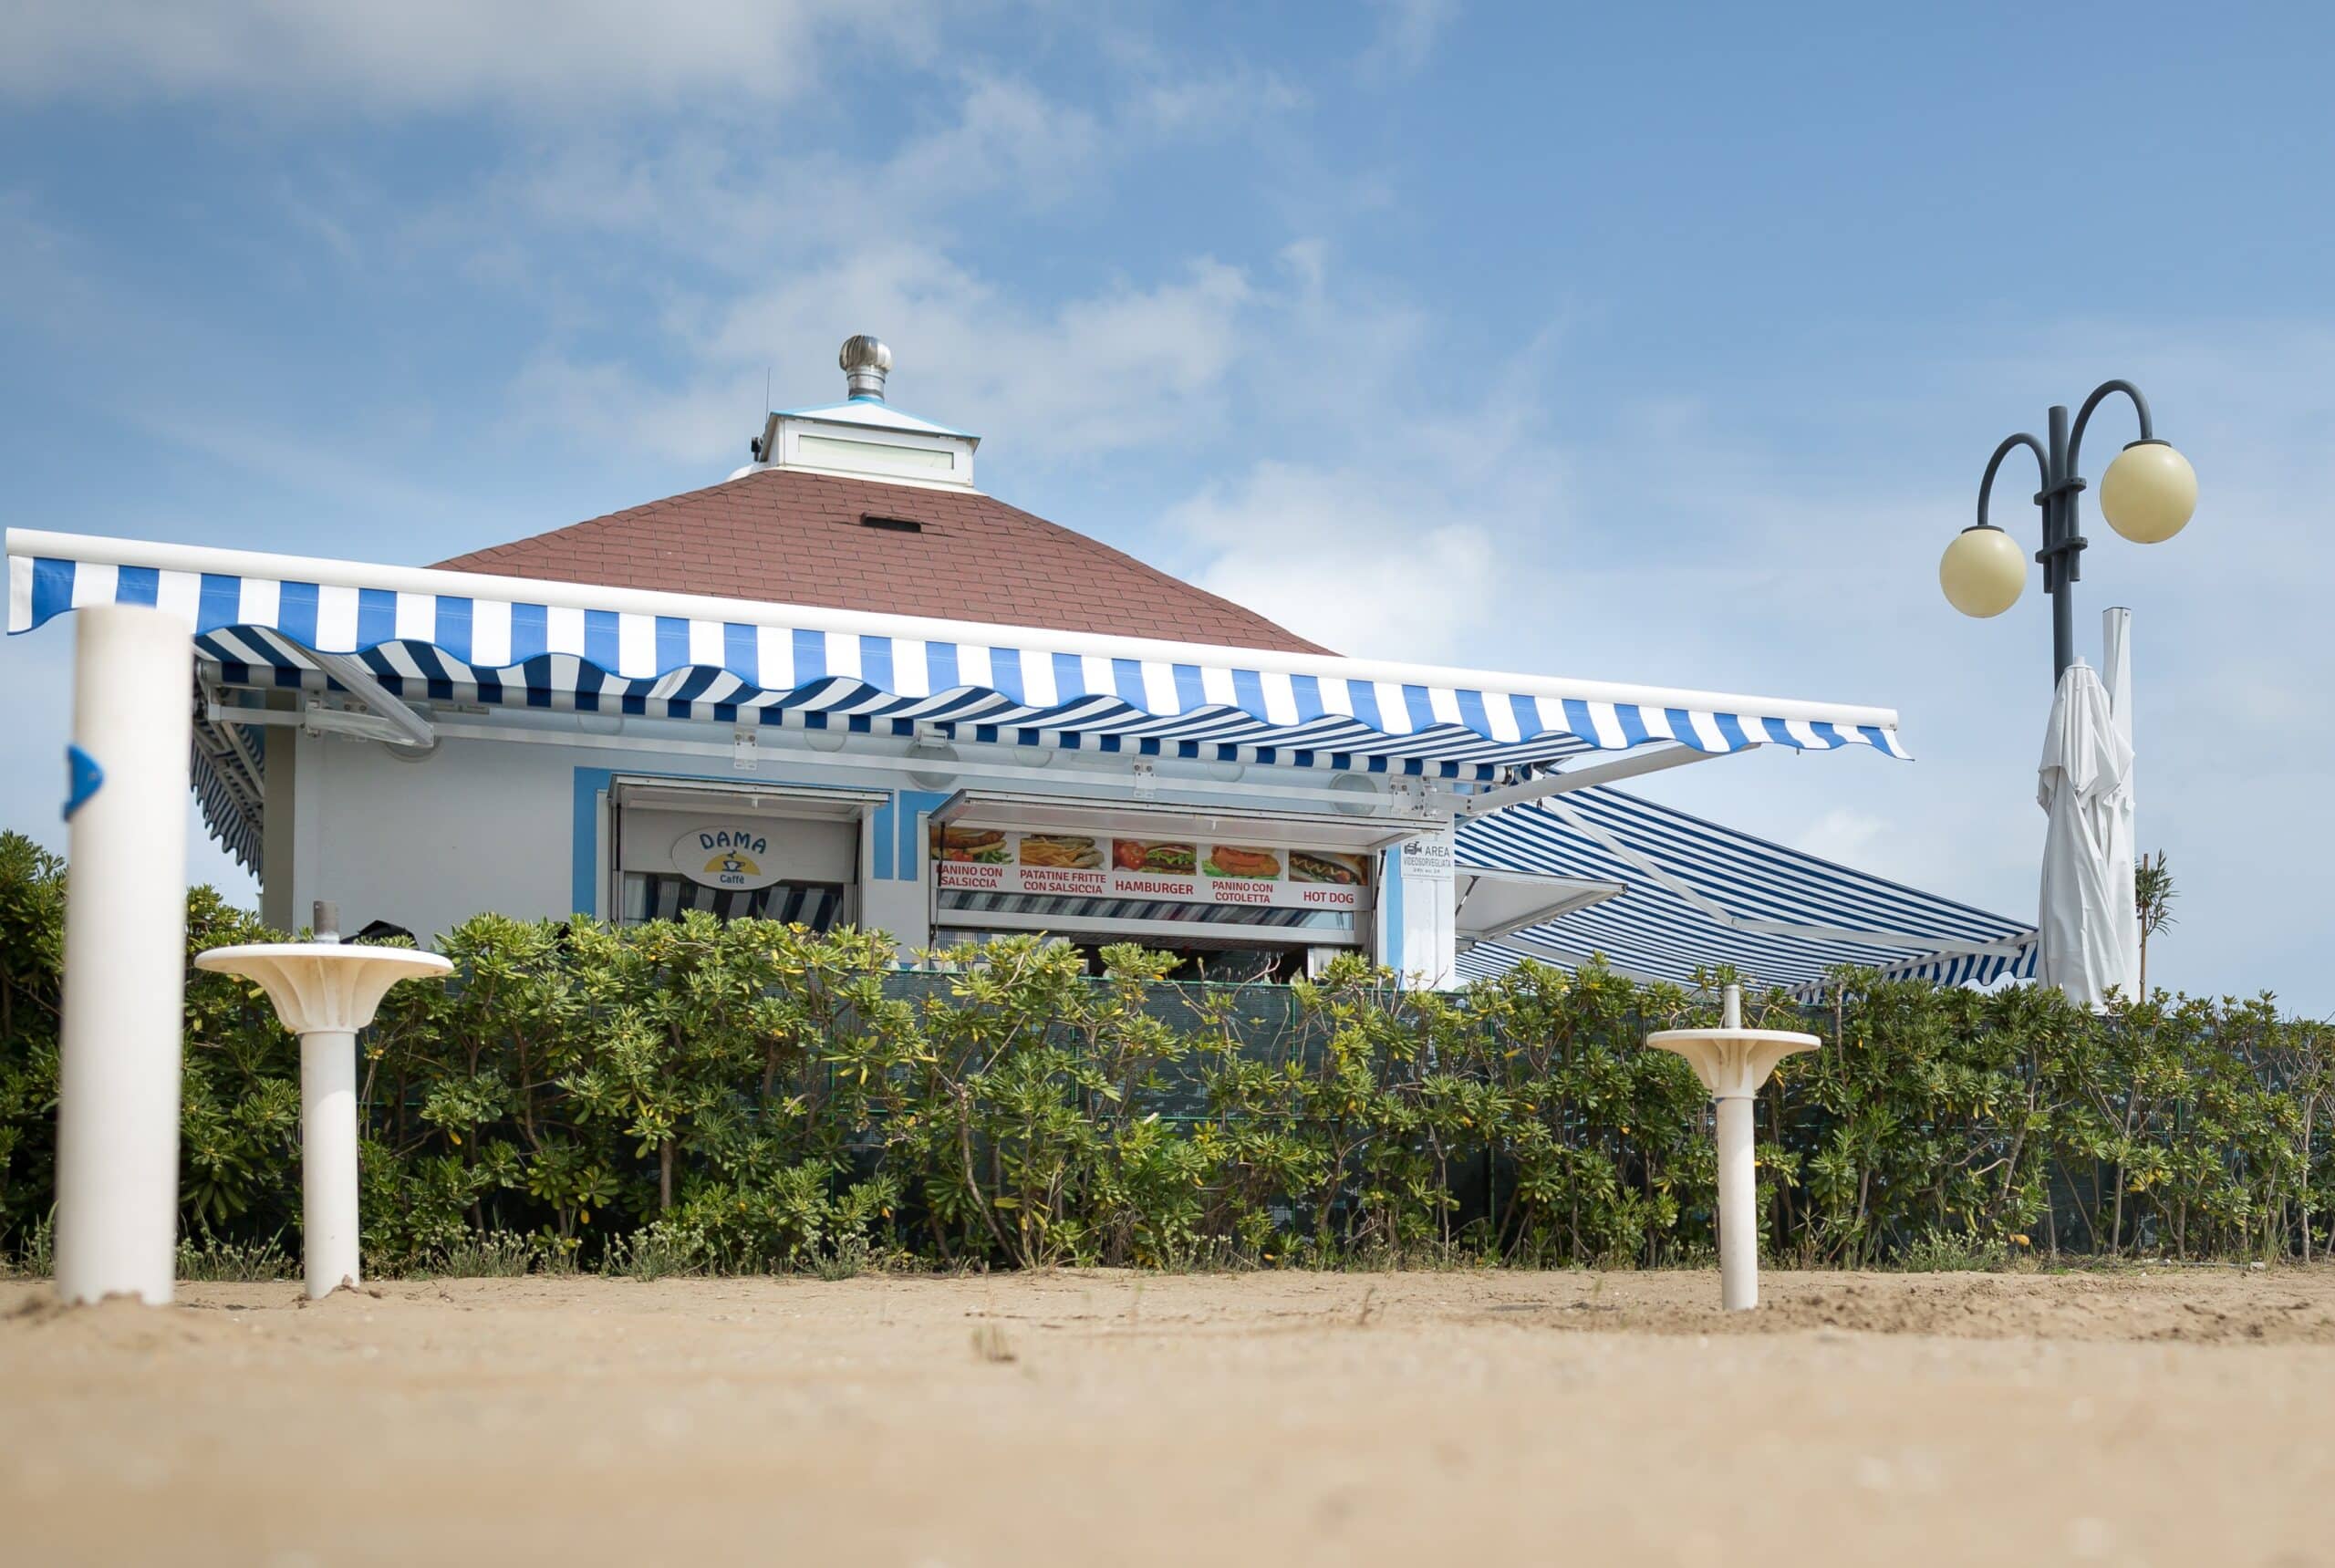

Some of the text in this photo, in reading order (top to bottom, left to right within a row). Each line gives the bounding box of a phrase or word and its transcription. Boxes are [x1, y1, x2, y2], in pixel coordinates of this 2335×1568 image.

[699, 831, 766, 854] DAMA
[1425, 846, 1450, 857] AREA
[980, 867, 1002, 877] CON
[1020, 869, 1106, 883] PATATINE FRITTE
[720, 875, 744, 884] Caffè
[941, 876, 997, 888] SALSICCIA
[1023, 881, 1103, 894] CON SALSICCIA
[1115, 880, 1194, 895] HAMBURGER
[1212, 880, 1273, 893] PANINO CON
[1215, 891, 1271, 903] COTOLETTA
[1303, 891, 1354, 904] HOT DOG
